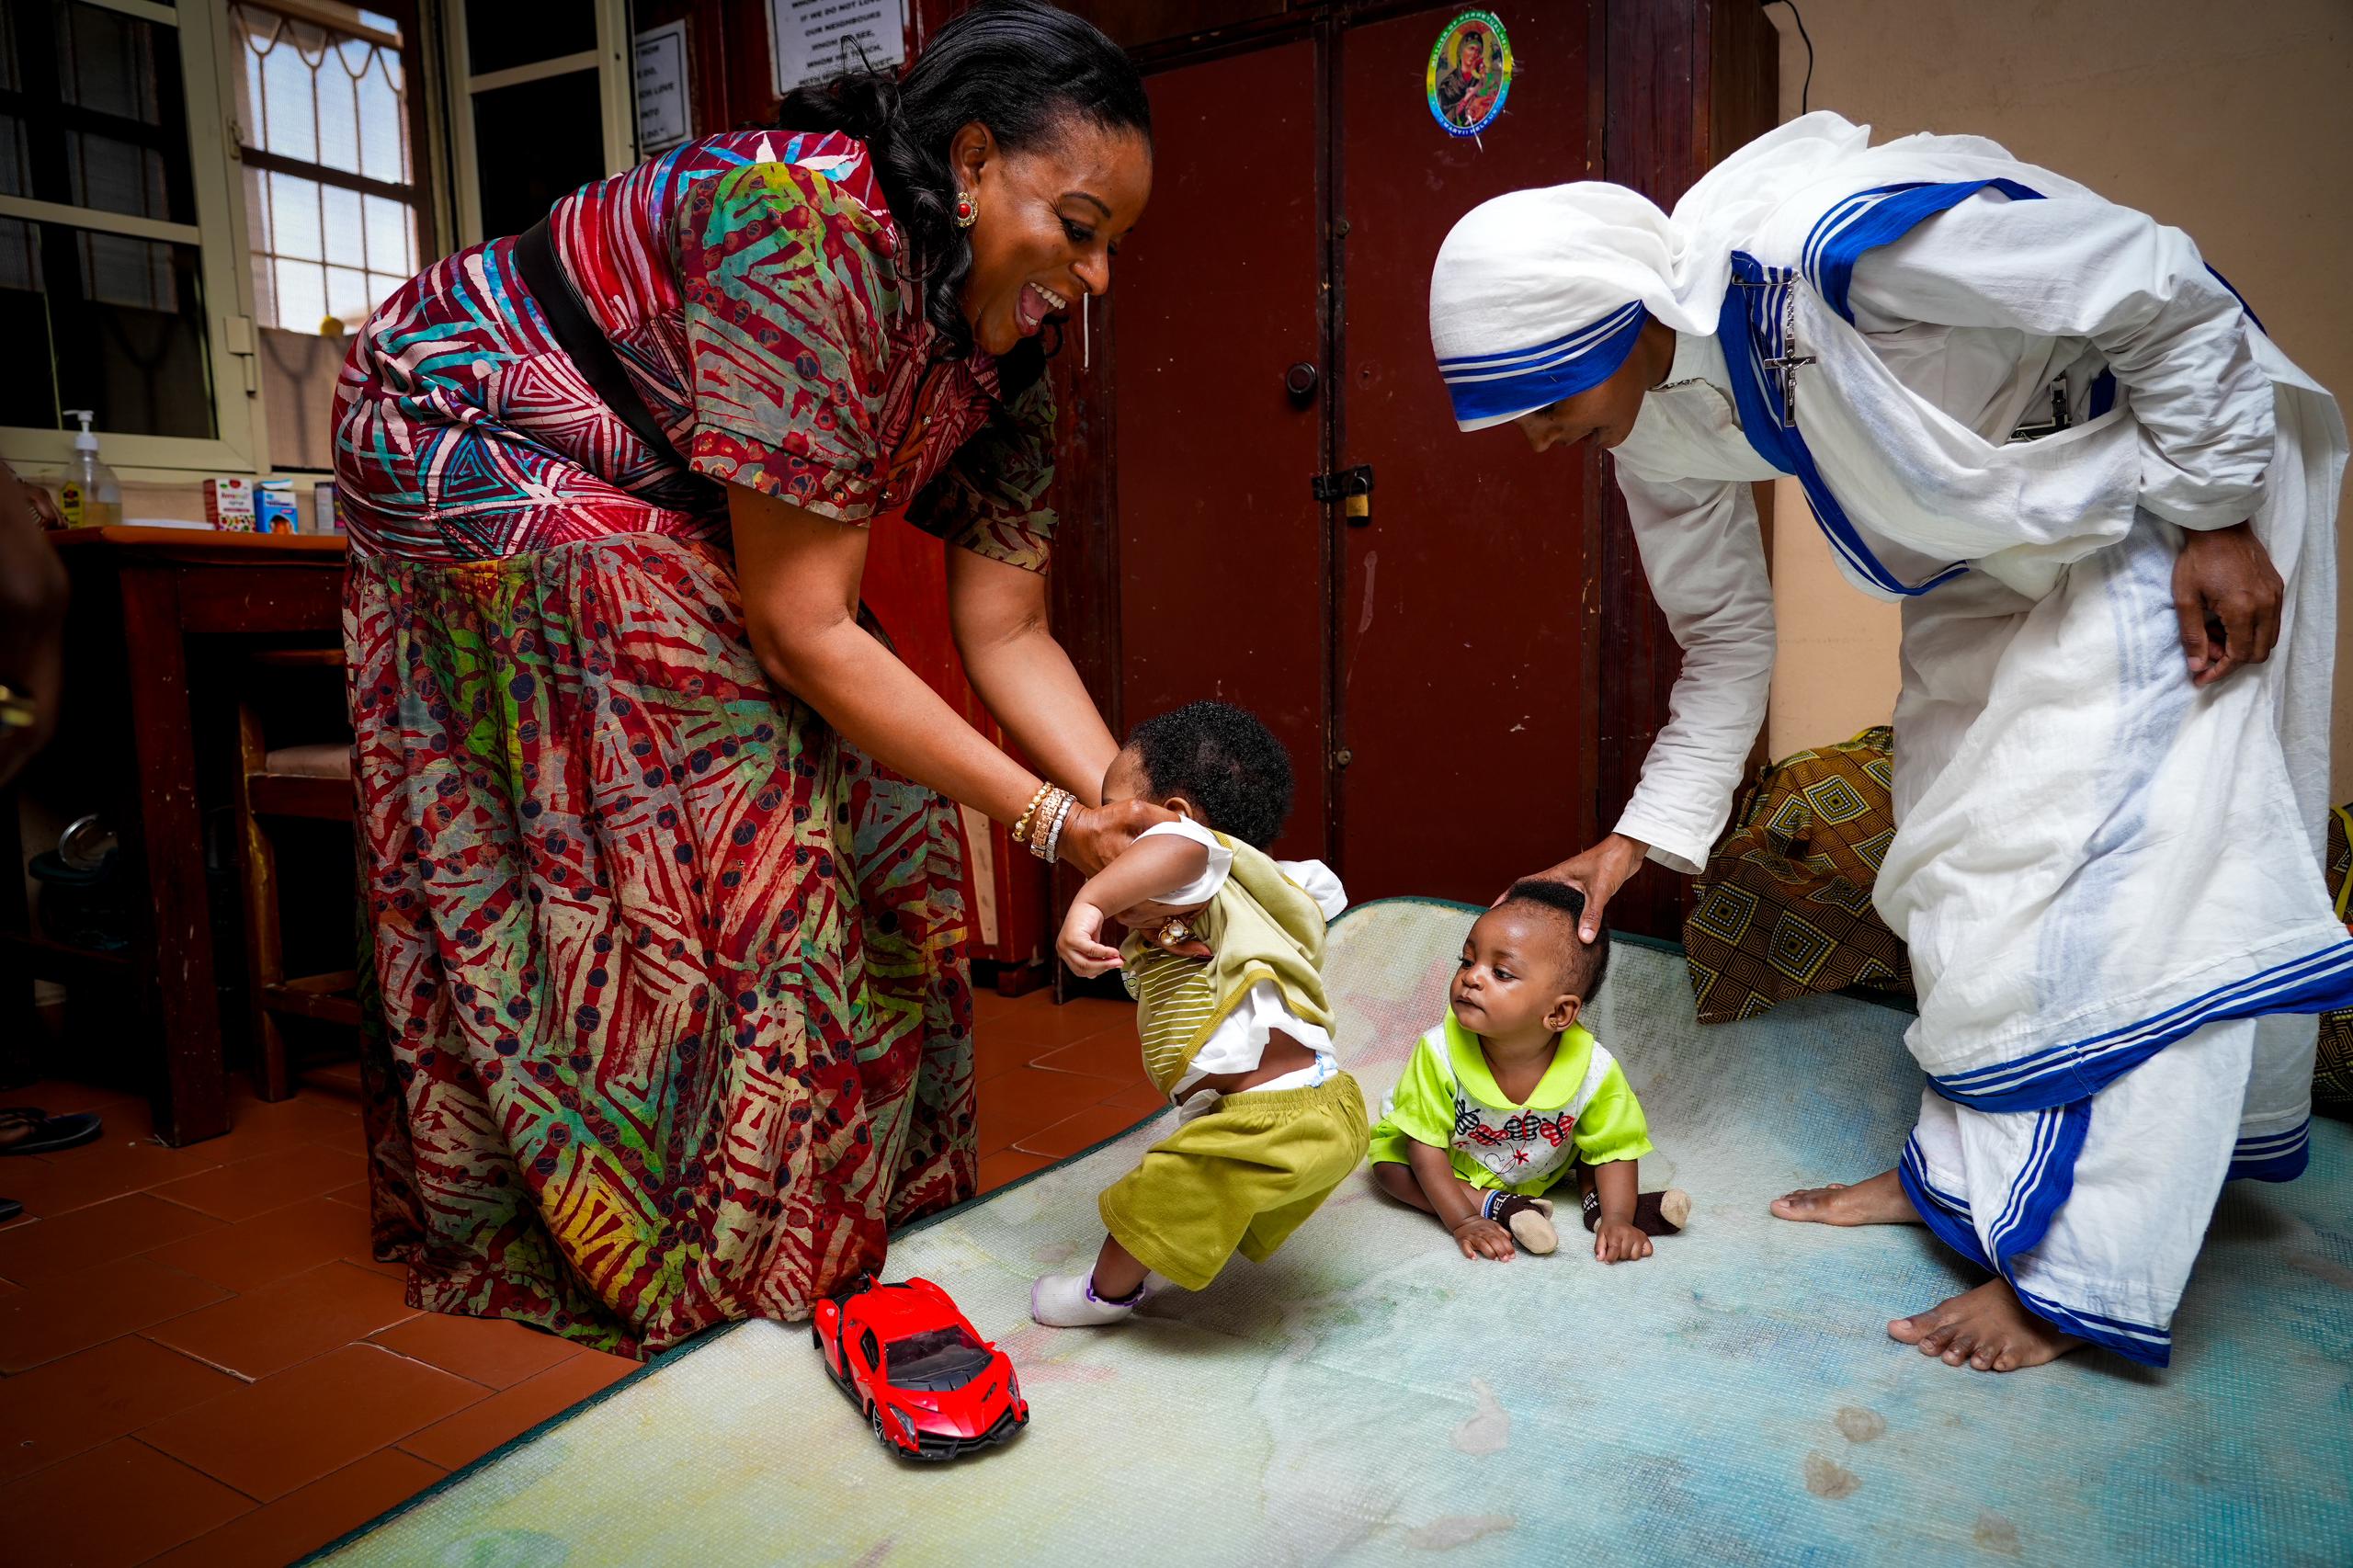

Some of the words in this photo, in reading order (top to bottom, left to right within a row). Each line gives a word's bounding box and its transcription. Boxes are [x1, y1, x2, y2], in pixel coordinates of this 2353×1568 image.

[824, 6, 837, 16] DO
[838, 2, 857, 11] NOT
[804, 26, 823, 37] OUR
[824, 10, 881, 31] NEIGHBOURS
